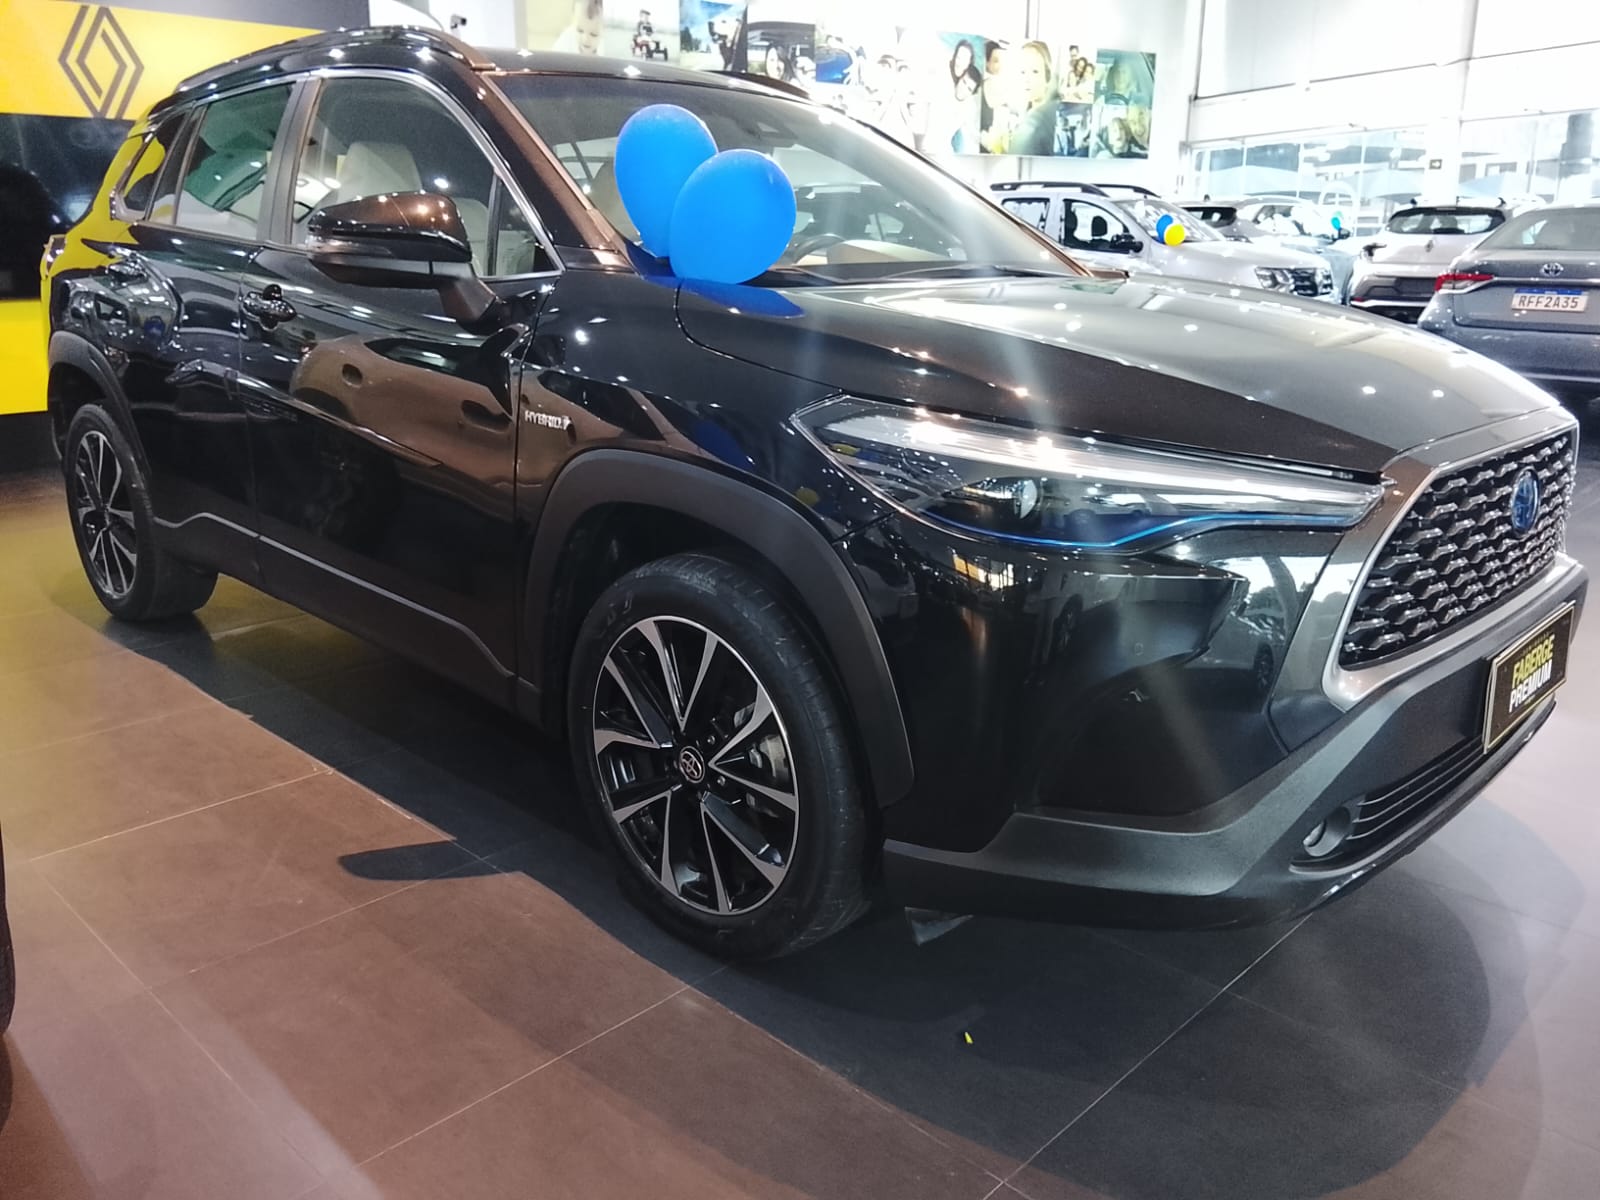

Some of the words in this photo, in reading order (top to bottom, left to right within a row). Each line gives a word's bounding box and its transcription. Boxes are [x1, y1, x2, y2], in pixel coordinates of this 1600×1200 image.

[1518, 295, 1579, 309] RFF2A35
[525, 410, 562, 428] HYBRID
[1512, 634, 1555, 689] FABERGE
[1509, 659, 1553, 713] PREMIUM
